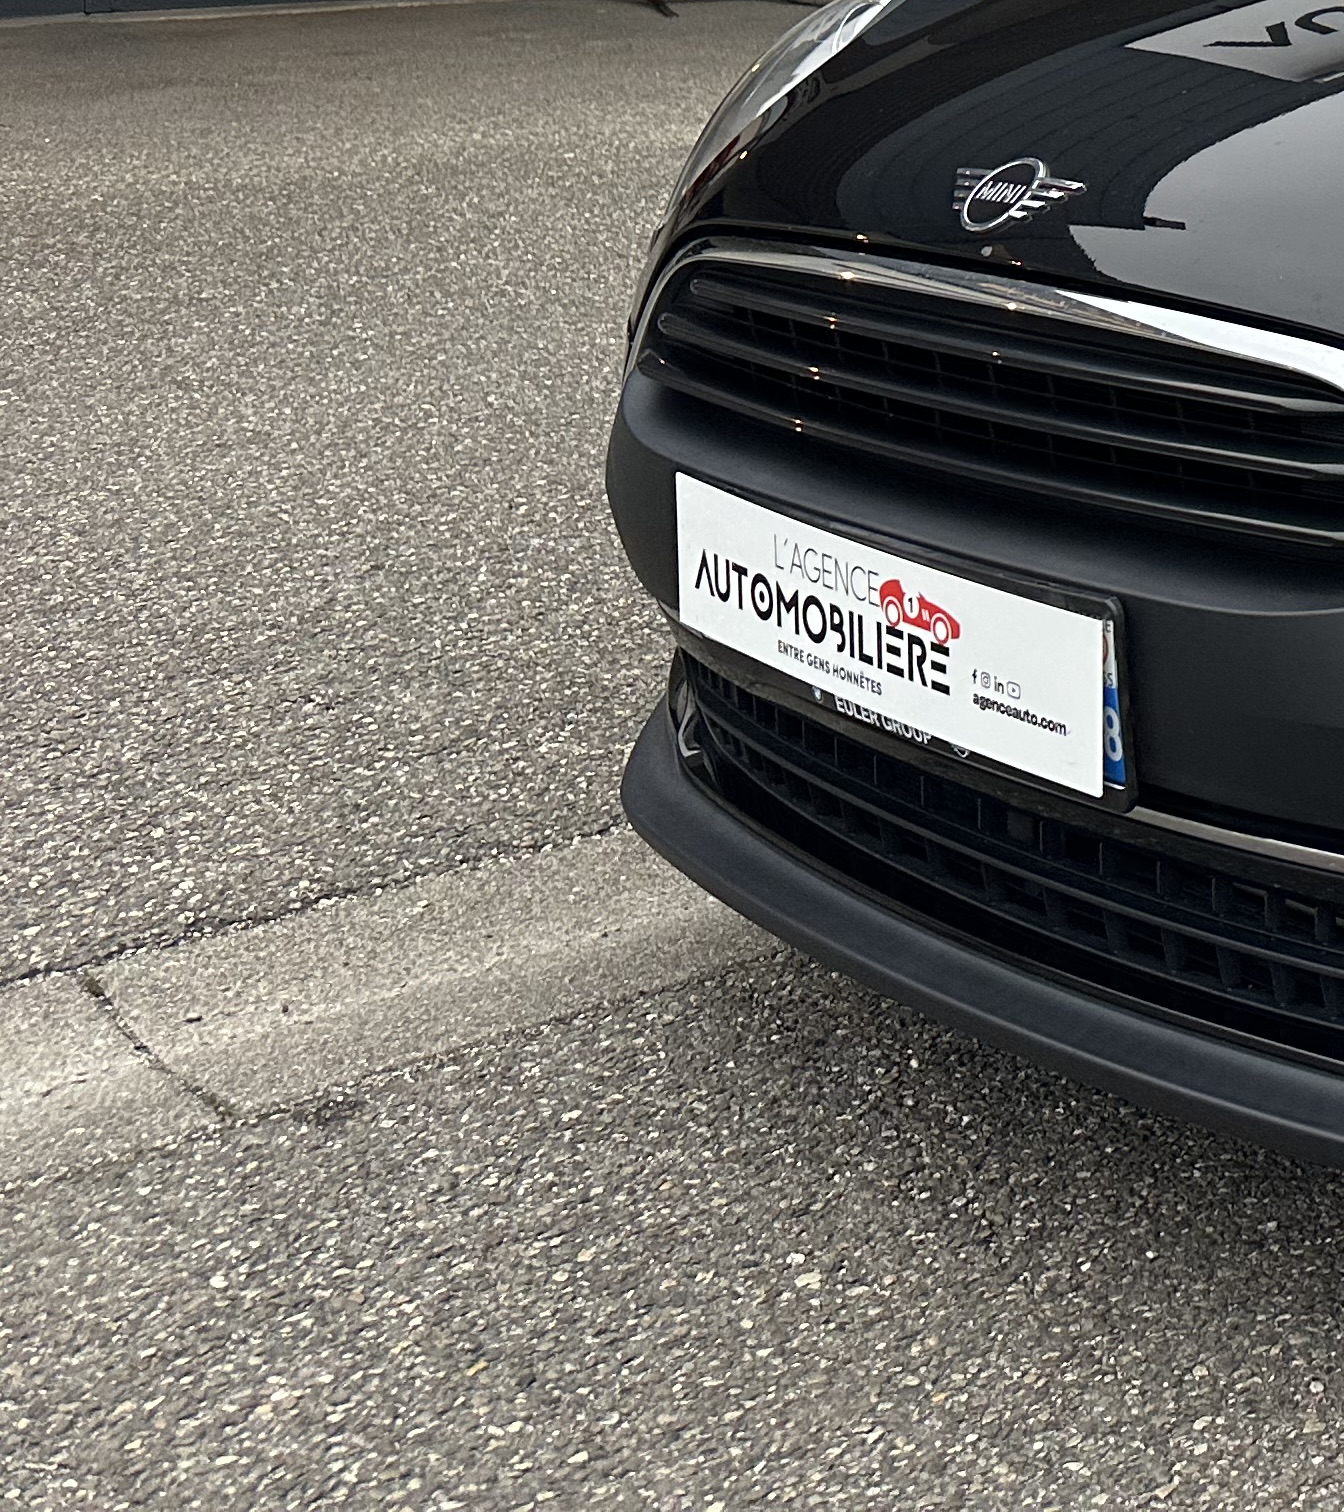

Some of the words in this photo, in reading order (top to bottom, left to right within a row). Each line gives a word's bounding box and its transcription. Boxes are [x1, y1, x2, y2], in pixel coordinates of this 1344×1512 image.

[975, 180, 1027, 204] MINI
[773, 533, 881, 608] L'AGENCE
[777, 639, 805, 664] ENTRE
[806, 652, 831, 675] GENS
[834, 694, 882, 728] EULER
[972, 692, 1067, 737] agenceauto.com
